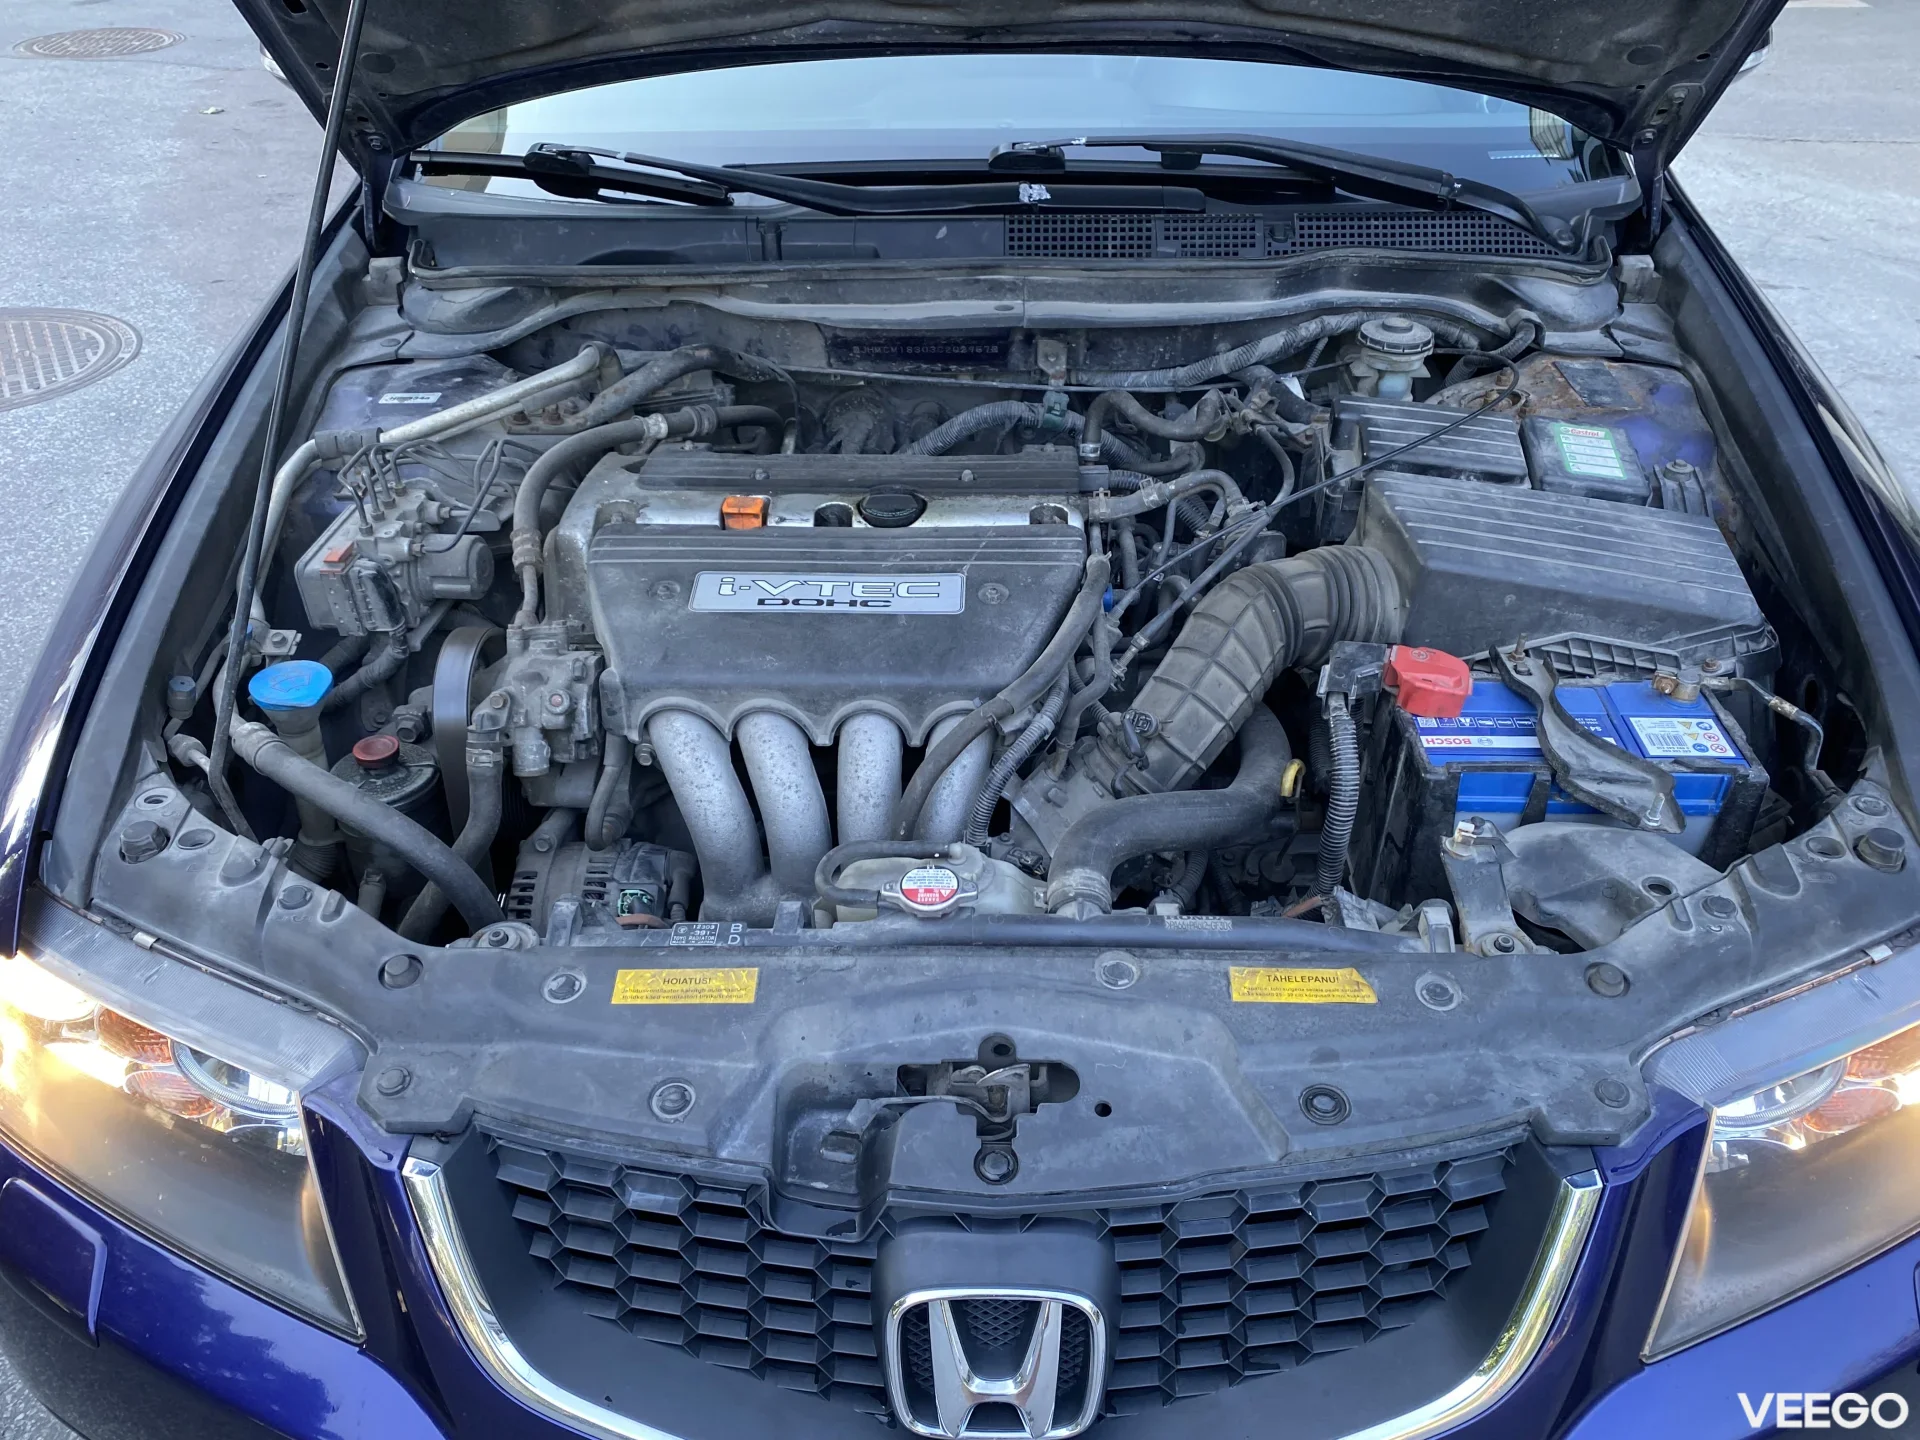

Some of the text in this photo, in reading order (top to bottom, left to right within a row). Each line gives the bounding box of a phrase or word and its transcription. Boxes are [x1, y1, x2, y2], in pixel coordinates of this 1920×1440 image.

[1570, 428, 1599, 437] Castrol
[718, 577, 941, 598] i-VTEC
[757, 598, 893, 608] DOHC
[1425, 737, 1472, 745] BOSCH
[730, 923, 743, 933] B
[727, 934, 741, 945] D
[663, 977, 711, 985] HOIATUS!
